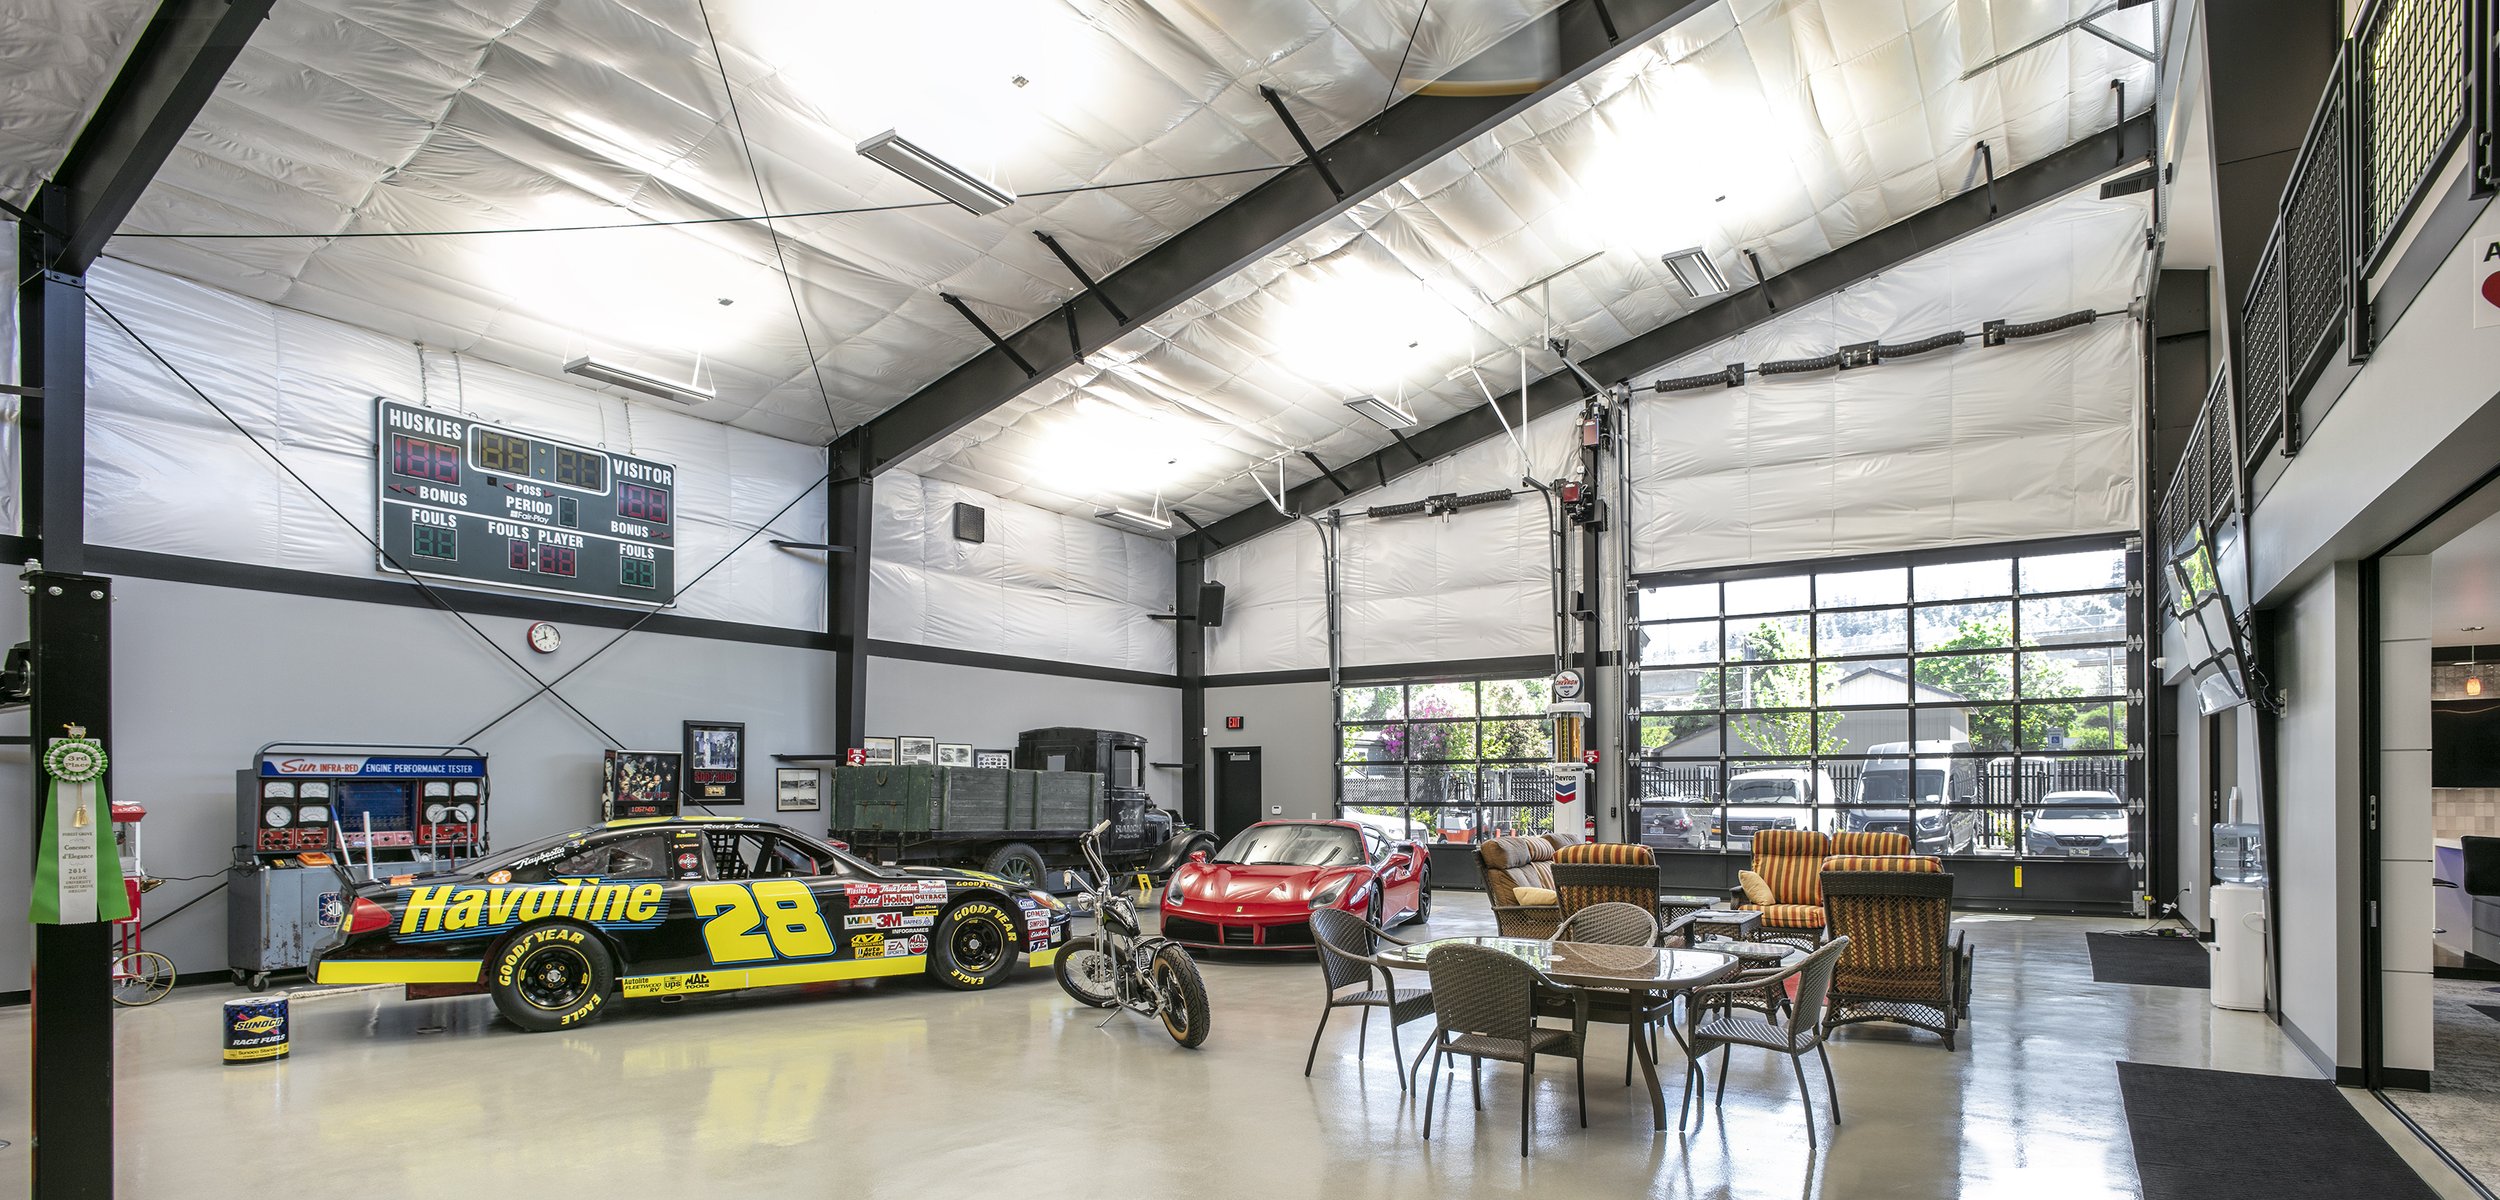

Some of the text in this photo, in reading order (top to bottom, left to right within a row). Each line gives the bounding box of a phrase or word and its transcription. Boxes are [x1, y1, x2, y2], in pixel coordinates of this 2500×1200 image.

[390, 409, 462, 440] HUSKIES
[613, 459, 672, 486] VISITOR
[420, 486, 468, 506] BONUS
[516, 484, 542, 497] POSS
[506, 495, 553, 515] PERIOD
[412, 508, 457, 527] FOULS
[518, 511, 549, 525] Fair-Play
[488, 521, 584, 548] FOULS PLAYER
[611, 521, 649, 538] BONUS
[620, 543, 654, 560] FOULS
[1228, 717, 1240, 728] EXIT
[281, 759, 473, 774] Sun INFRA-RED ENGINE PERFORMANCE TESTER
[509, 846, 566, 870] Raybestos
[956, 880, 1004, 890] GOODYEAR
[399, 877, 664, 934] Havoline
[858, 895, 881, 904] Bud
[883, 894, 912, 906] Holley
[688, 881, 836, 964] 28
[877, 913, 902, 928] 3M
[953, 904, 1018, 942] GOODYEAR
[1030, 919, 1047, 928] SIMPSON
[888, 941, 905, 950] EA
[499, 929, 585, 986] GOODYEAR
[624, 977, 649, 985] Autolite
[685, 973, 709, 985] MAC
[951, 969, 985, 985] EAGLE
[625, 982, 661, 990] FLEETWOOD
[665, 981, 681, 989] ups
[561, 993, 602, 1025] EAGLE
[237, 1017, 283, 1030] SUNOCO
[233, 1034, 286, 1046] RACE FUELS
